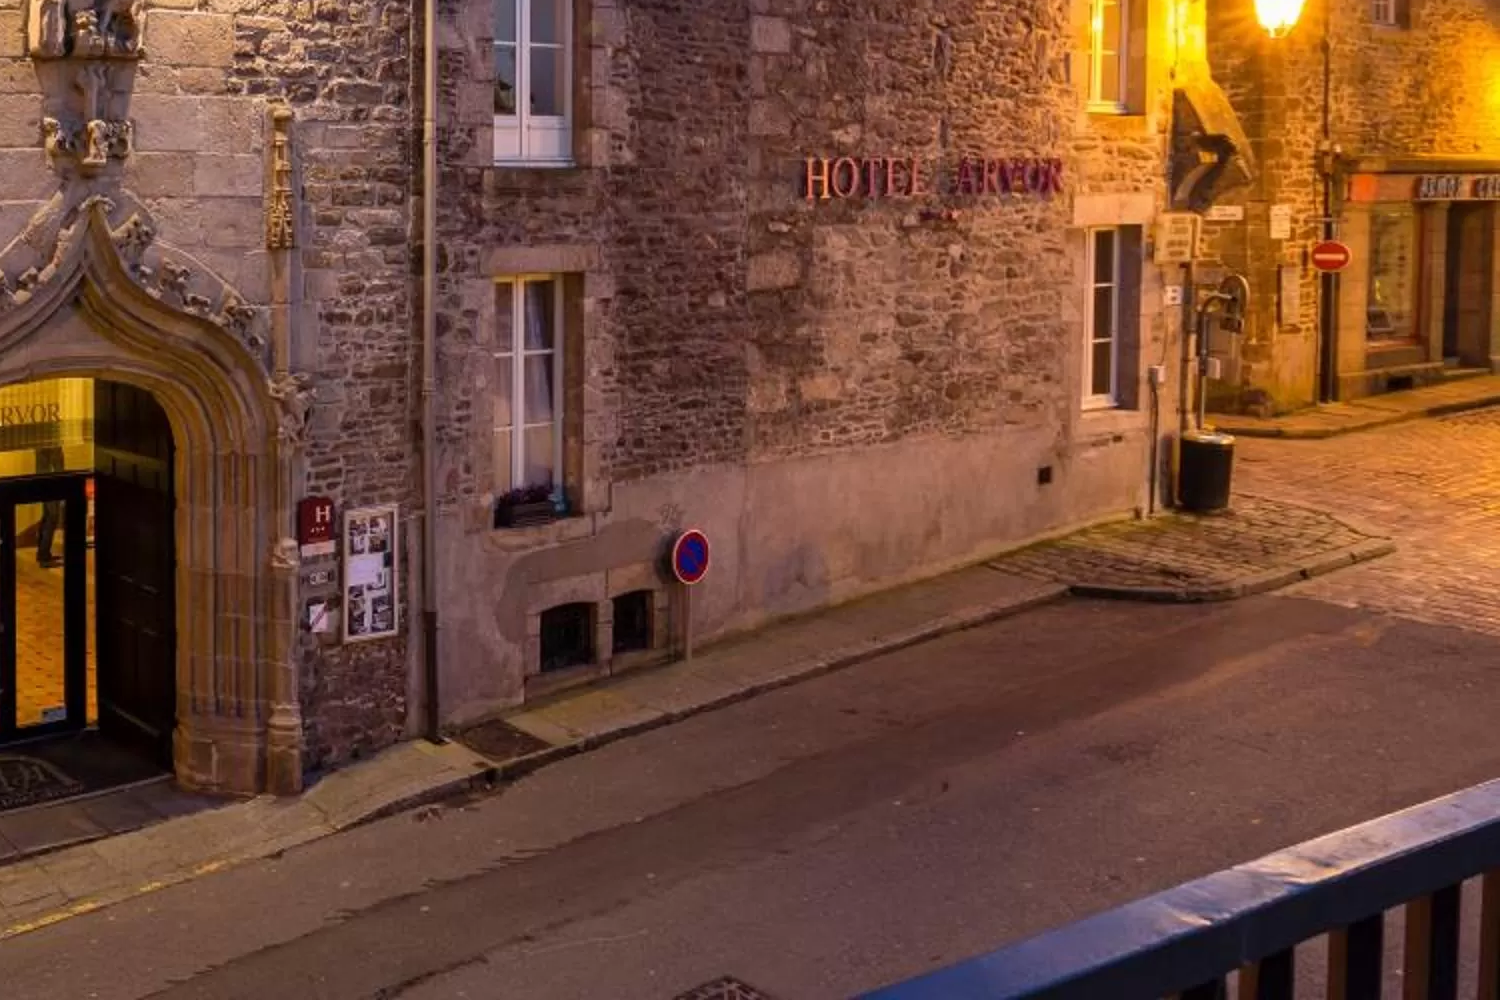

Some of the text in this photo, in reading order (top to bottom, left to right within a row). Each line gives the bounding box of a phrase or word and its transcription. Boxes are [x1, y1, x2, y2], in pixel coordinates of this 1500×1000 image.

[806, 156, 1063, 200] HOTEL ARVOR
[315, 505, 331, 523] H
